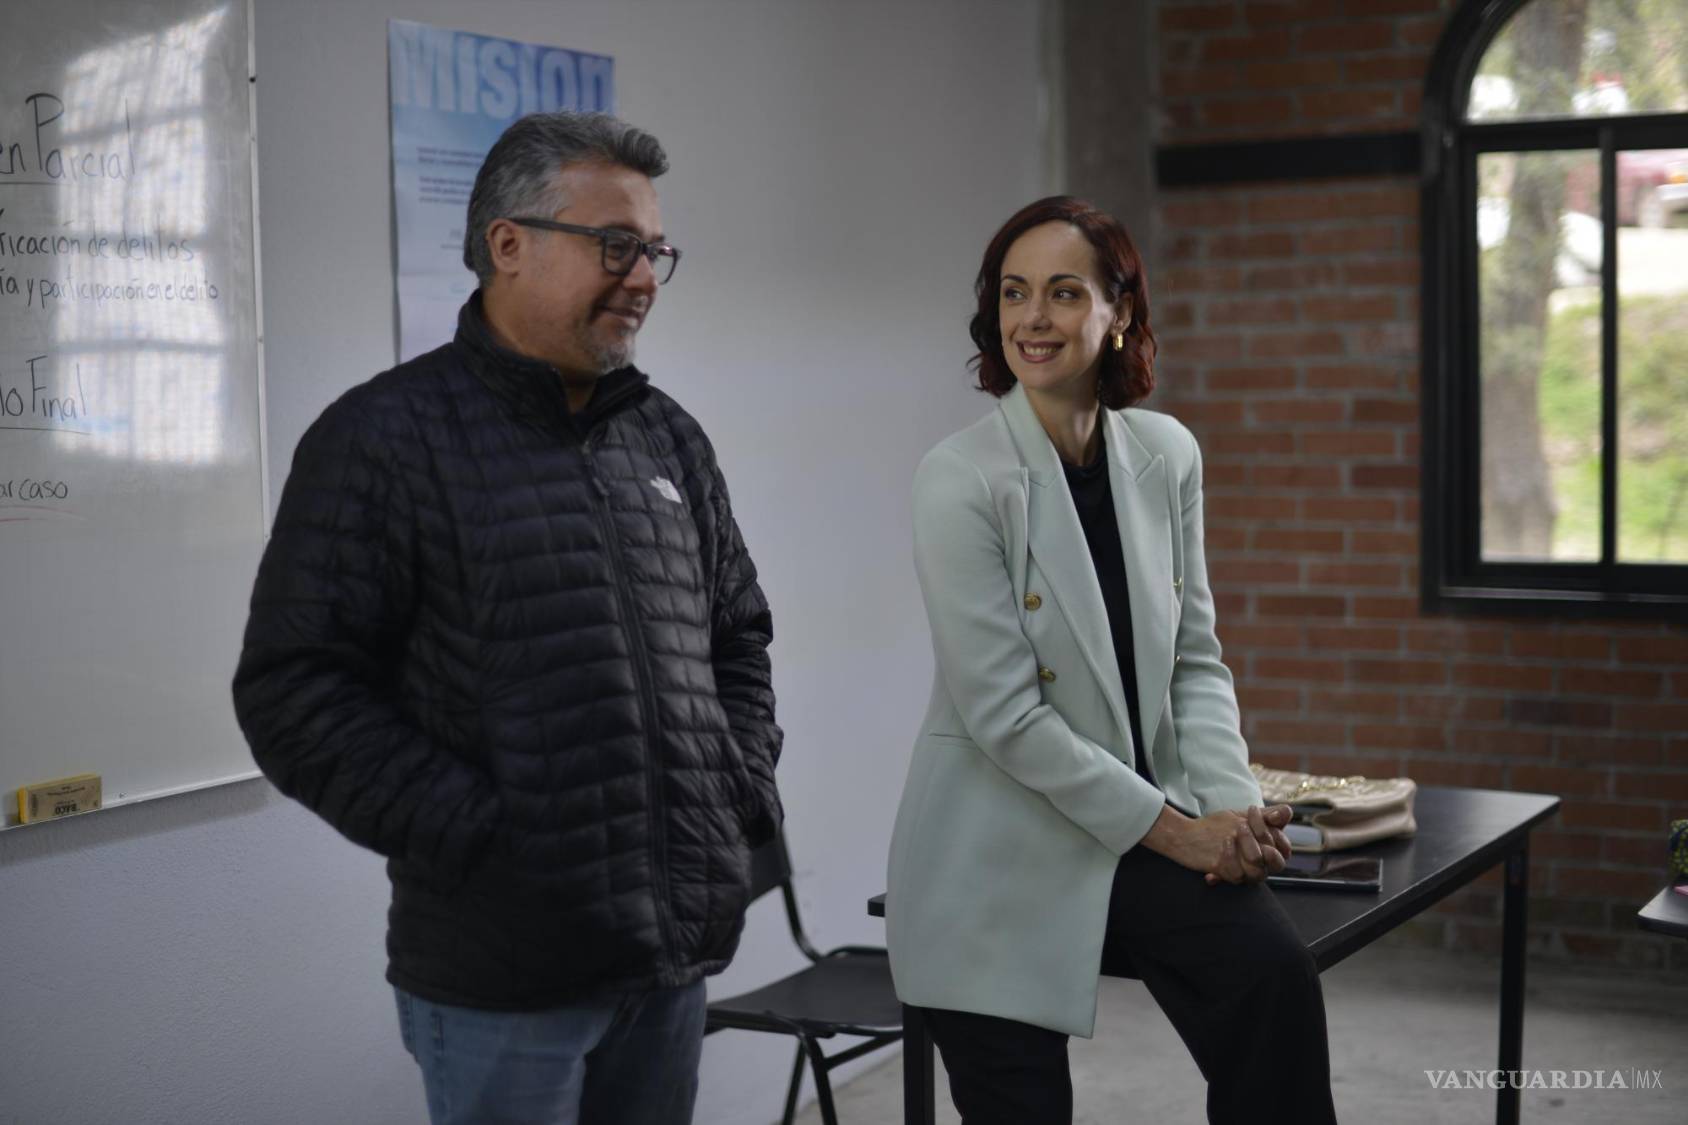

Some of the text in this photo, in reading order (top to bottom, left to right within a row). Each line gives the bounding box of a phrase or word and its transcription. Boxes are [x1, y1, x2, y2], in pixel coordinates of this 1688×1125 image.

[25, 93, 136, 182] Parcial
[88, 220, 108, 258] de
[117, 214, 194, 262] delitos
[27, 278, 34, 308] y
[26, 356, 87, 421] Final
[18, 478, 69, 501] caso
